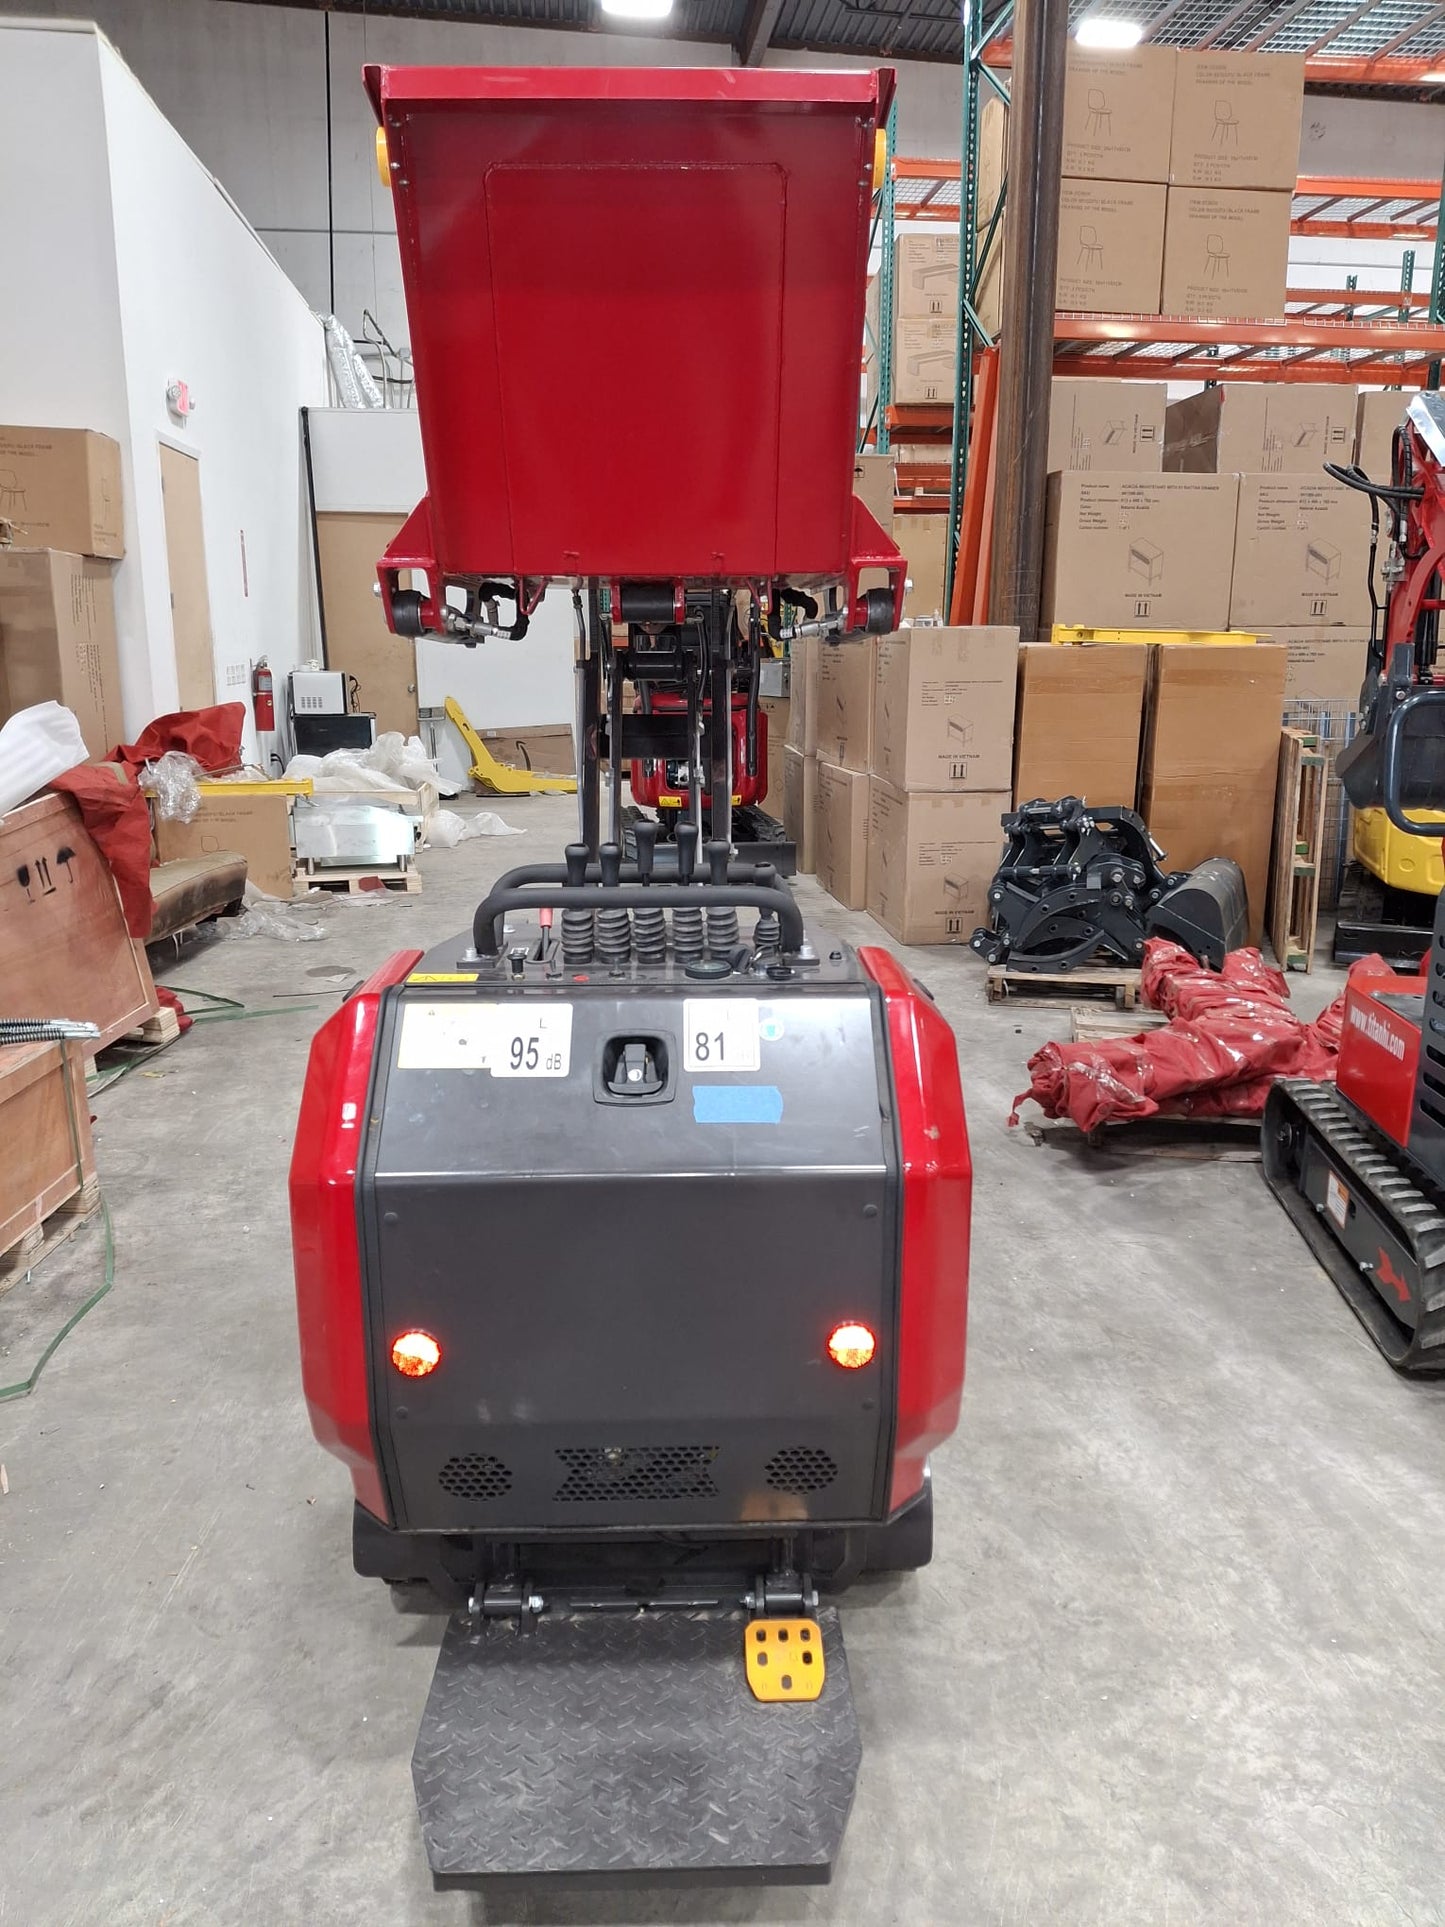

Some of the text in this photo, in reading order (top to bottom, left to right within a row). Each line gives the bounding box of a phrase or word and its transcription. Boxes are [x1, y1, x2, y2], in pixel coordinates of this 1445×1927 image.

[510, 1036, 562, 1070] 95 dB
[695, 1032, 724, 1061] 81
